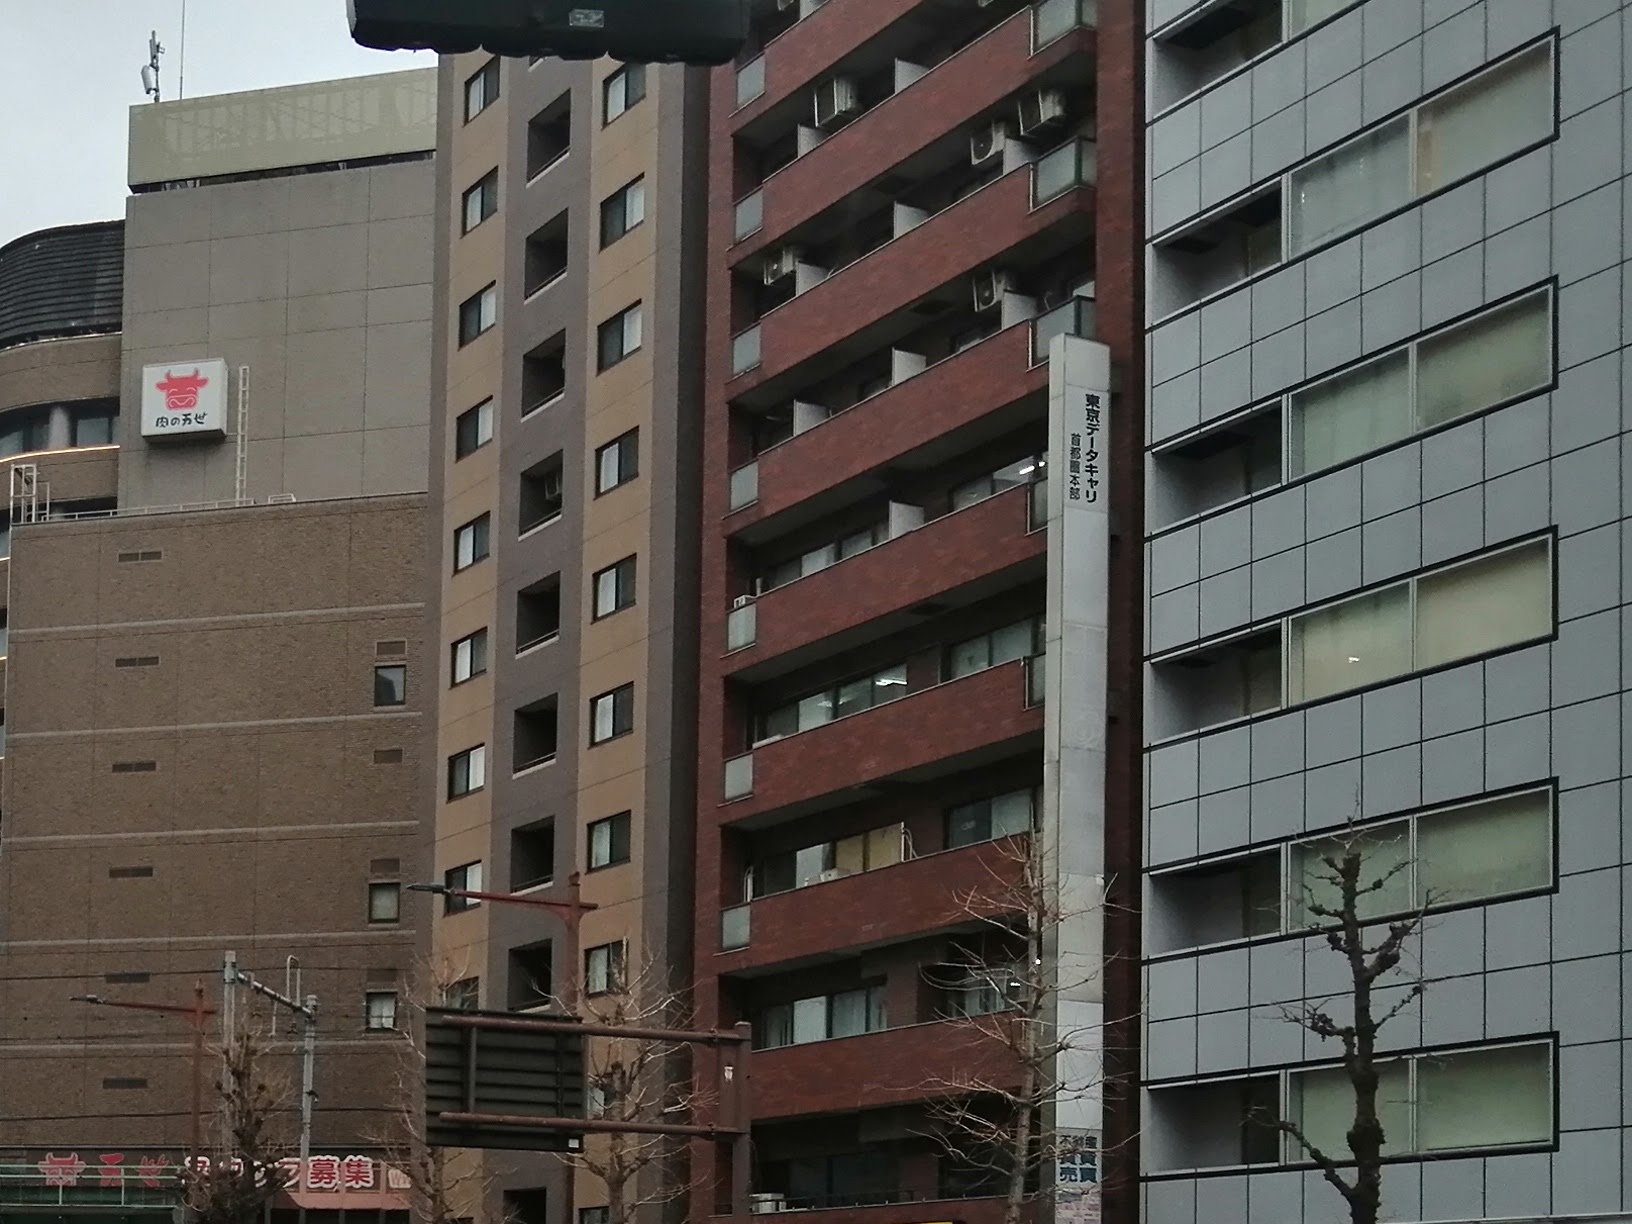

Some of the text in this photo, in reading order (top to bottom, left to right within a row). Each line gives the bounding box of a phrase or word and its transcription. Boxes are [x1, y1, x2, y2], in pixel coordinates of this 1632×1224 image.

[155, 412, 208, 428] 肉の万世
[1085, 393, 1101, 503] 東京データキャリ
